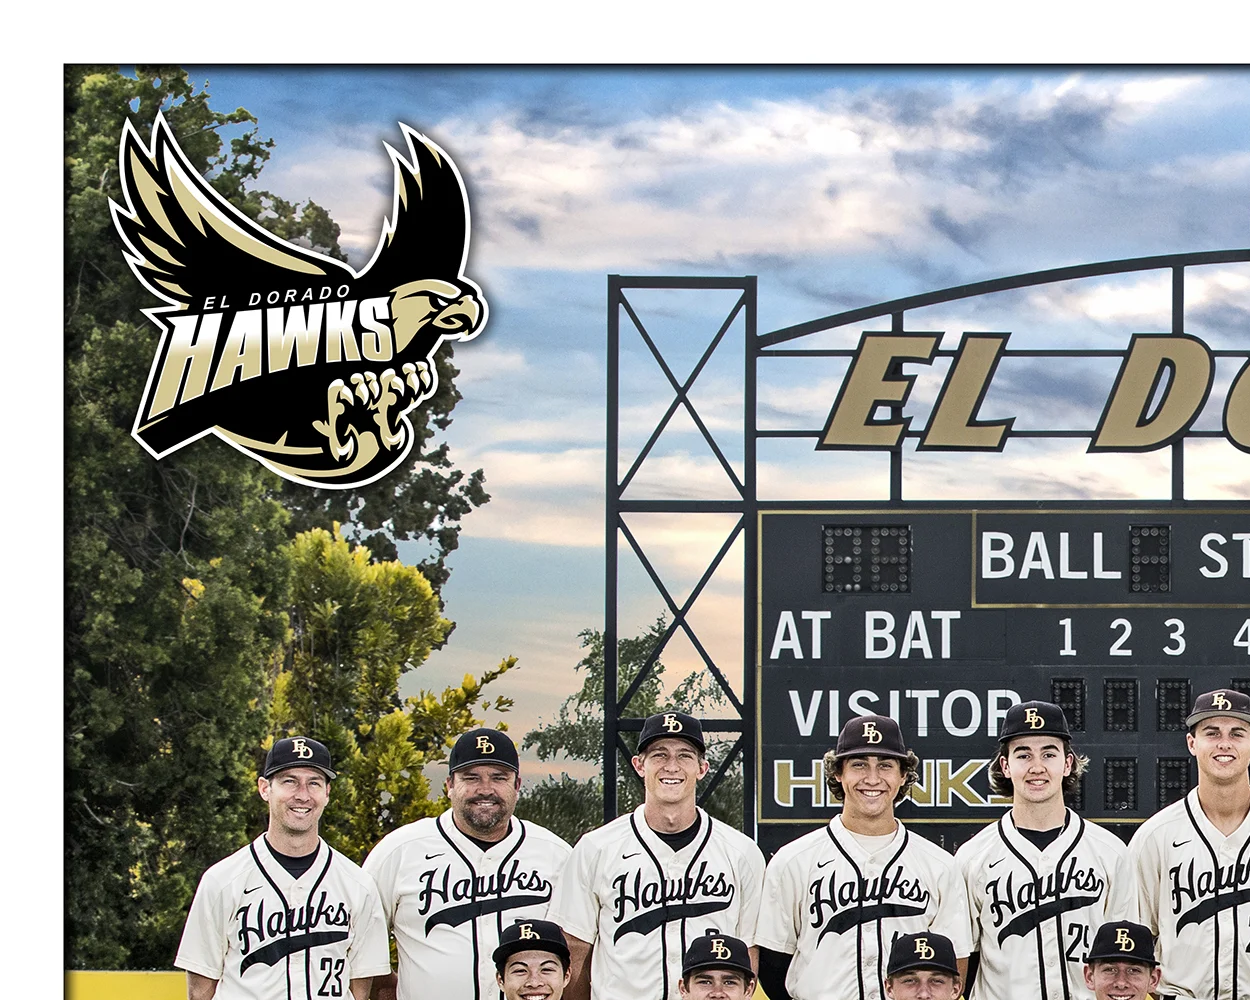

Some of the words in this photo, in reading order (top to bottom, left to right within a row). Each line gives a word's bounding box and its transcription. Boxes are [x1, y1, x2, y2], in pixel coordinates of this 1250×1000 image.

[816, 331, 1016, 454] EL
[981, 531, 1122, 580] BALL
[769, 611, 831, 659] AT
[865, 611, 961, 659] BAT
[1058, 618, 1078, 656] 1
[1109, 618, 1133, 656] 2
[1163, 618, 1187, 656] 3
[419, 859, 550, 915] Hawks
[612, 861, 731, 923] Hawks
[810, 866, 928, 928] Hawks
[986, 856, 1102, 927] Hawks
[237, 891, 349, 955] Hawks
[318, 957, 344, 996] 23
